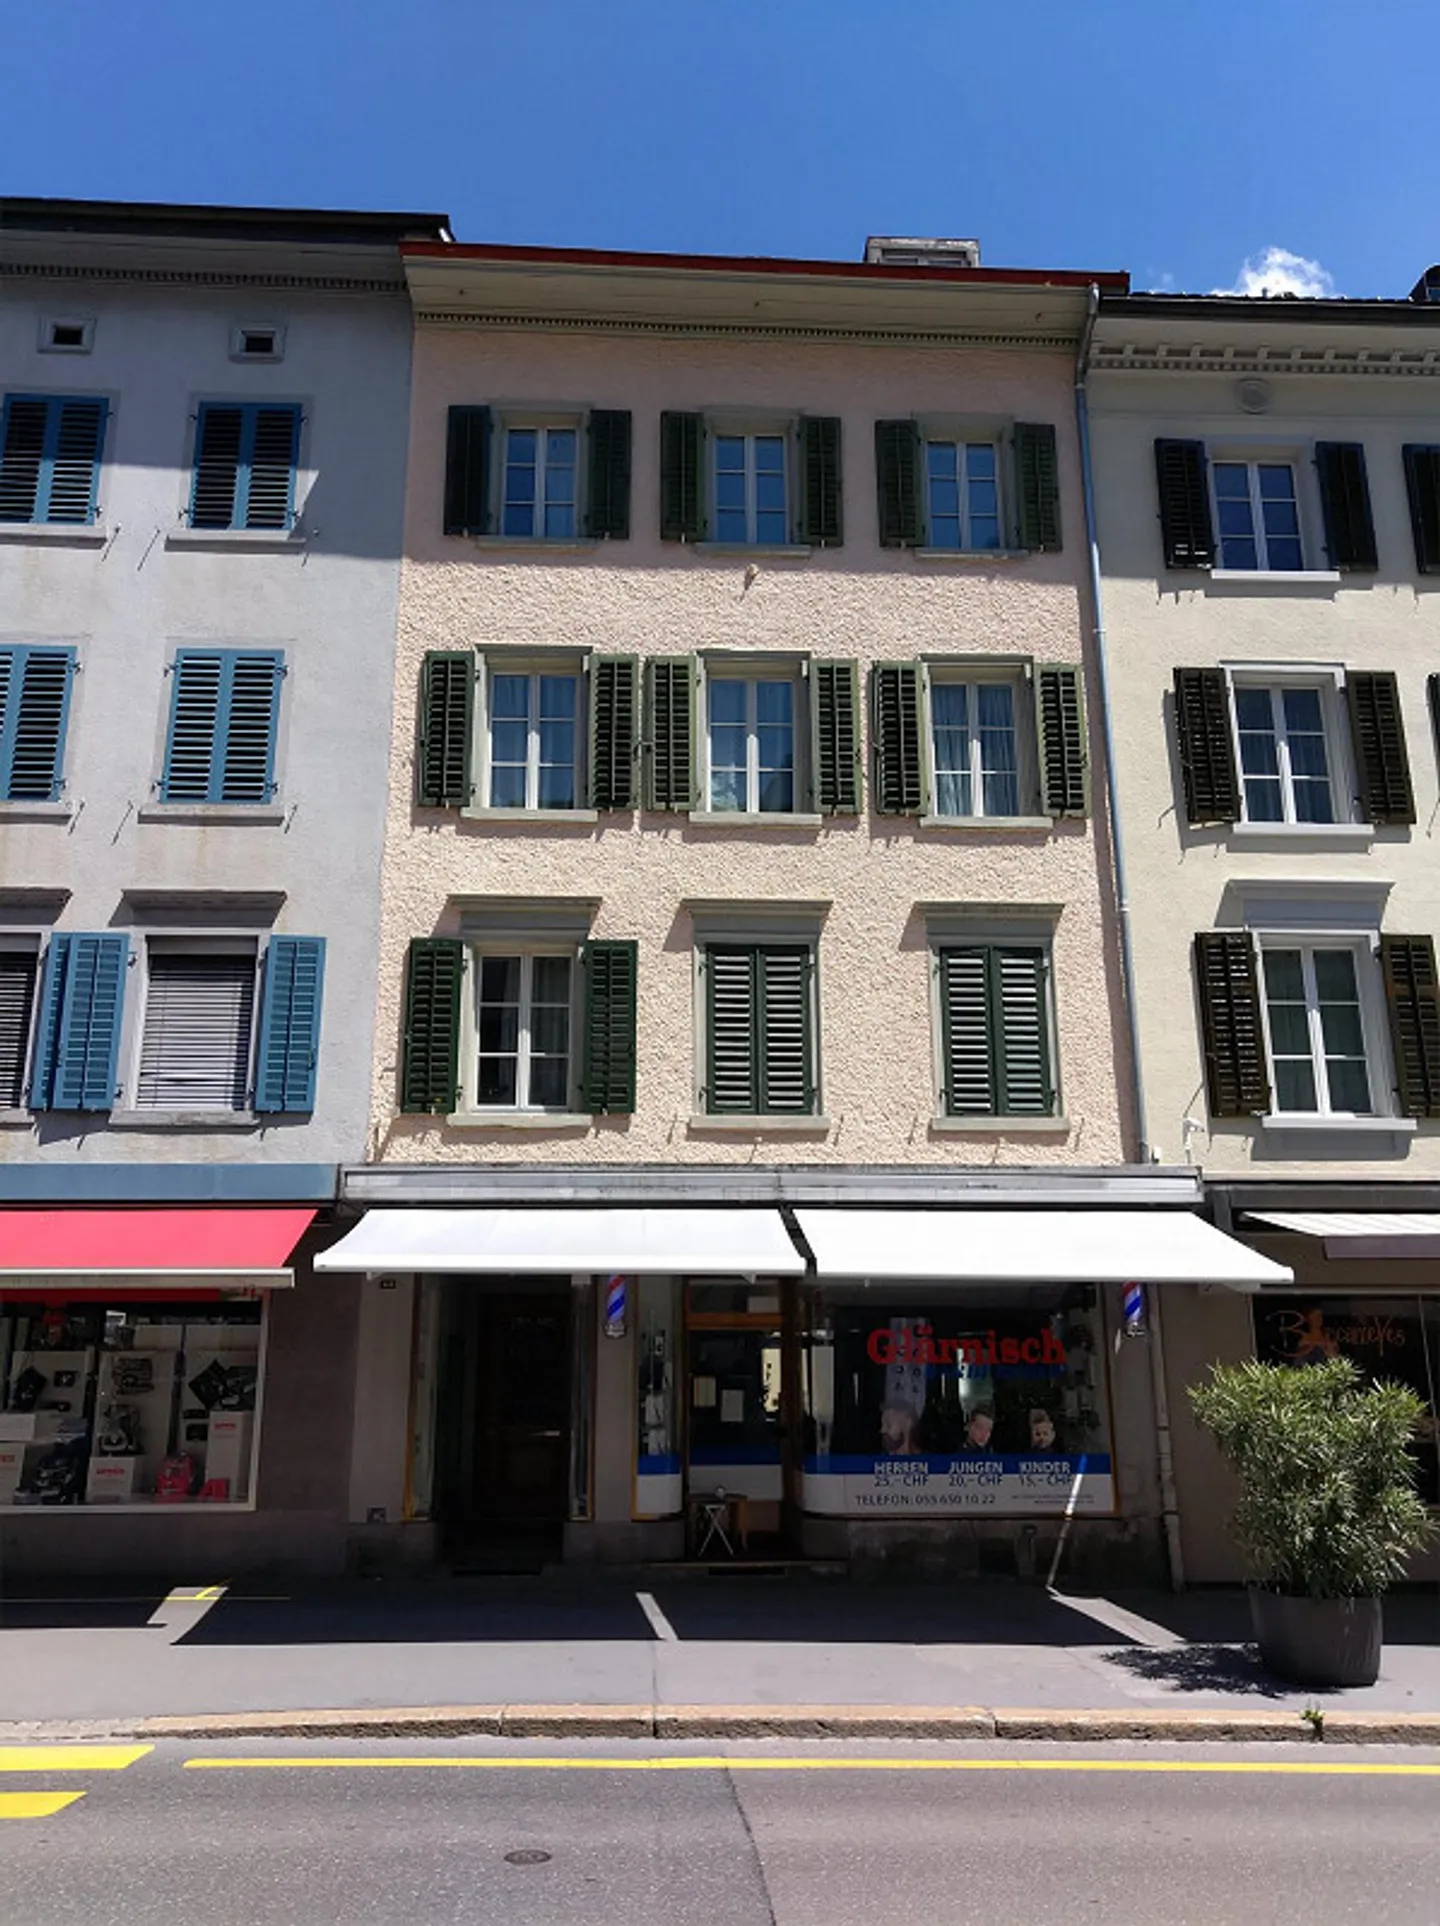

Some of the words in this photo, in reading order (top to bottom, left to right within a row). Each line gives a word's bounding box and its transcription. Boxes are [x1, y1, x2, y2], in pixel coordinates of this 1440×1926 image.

[866, 1323, 1066, 1366] Glärnisch
[873, 1461, 929, 1474] HERREN
[949, 1461, 1003, 1474] JUNGEN
[1018, 1461, 1071, 1474] KINDER
[903, 1474, 929, 1487] CHF
[978, 1474, 1004, 1487] CHF
